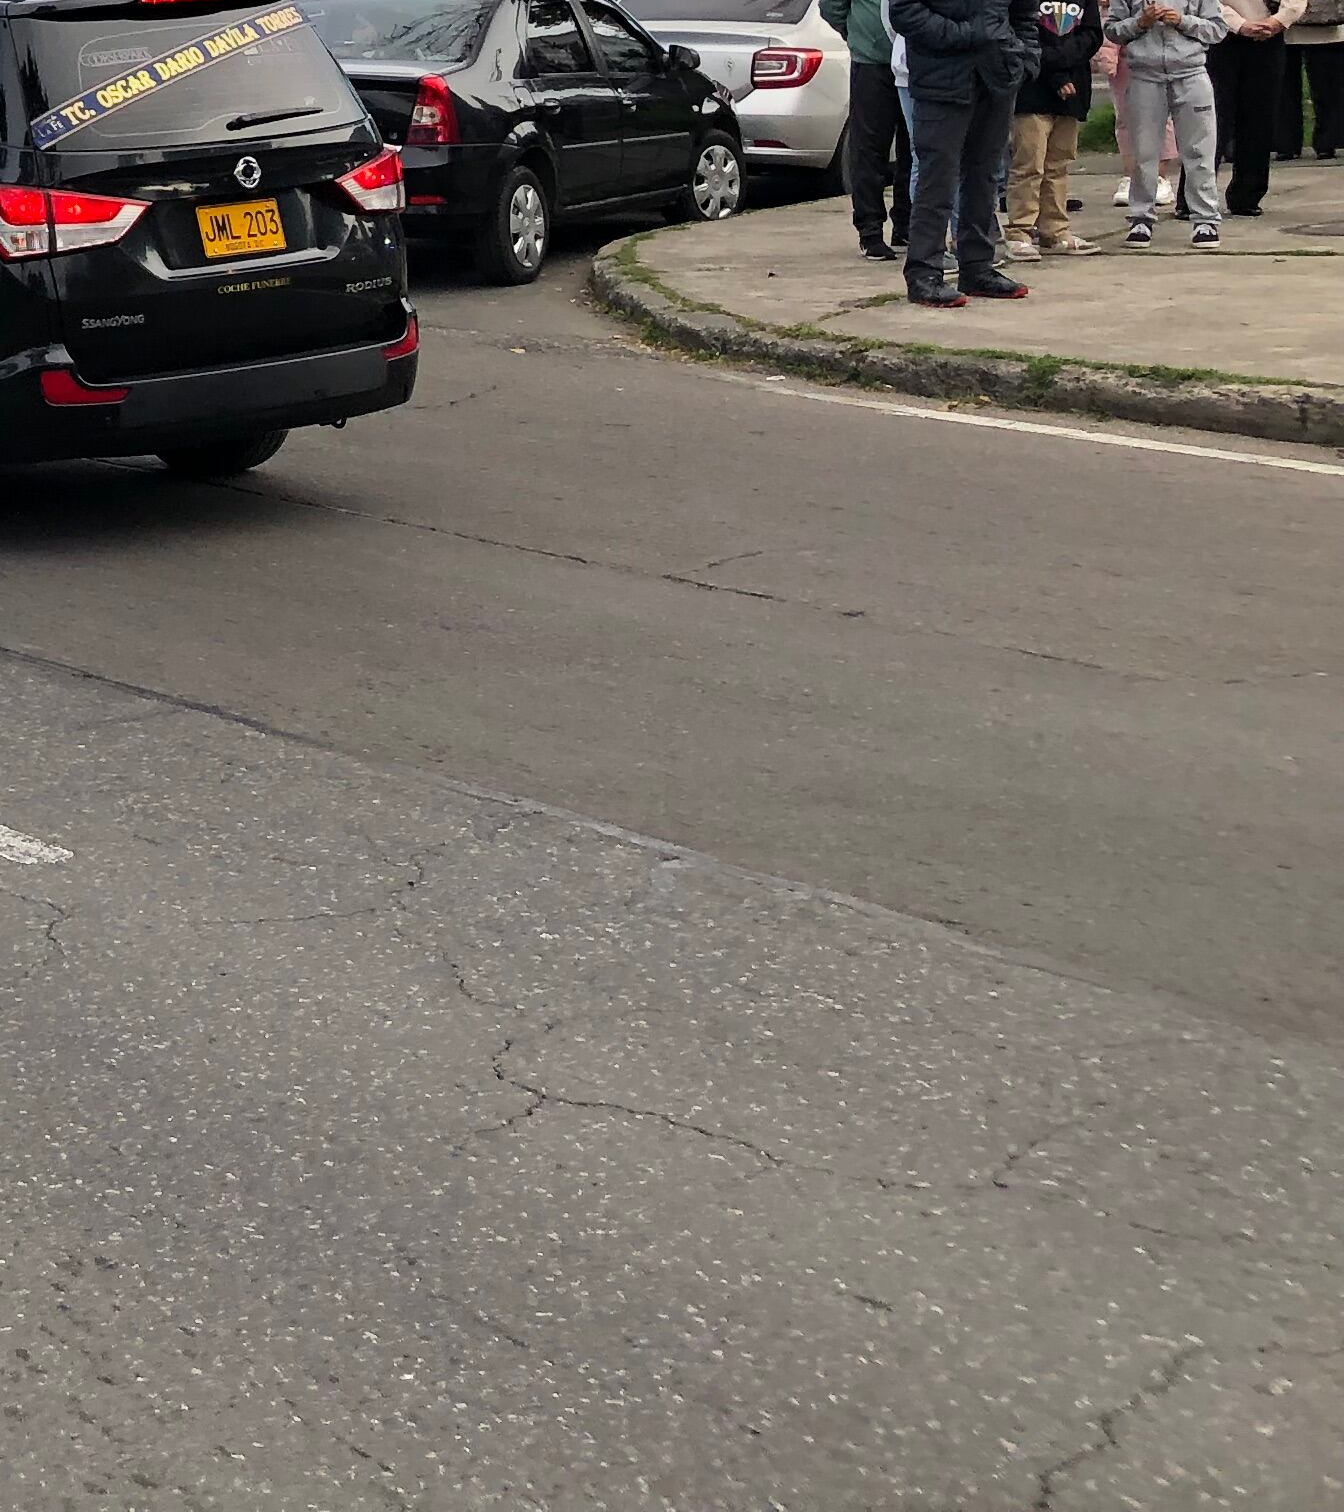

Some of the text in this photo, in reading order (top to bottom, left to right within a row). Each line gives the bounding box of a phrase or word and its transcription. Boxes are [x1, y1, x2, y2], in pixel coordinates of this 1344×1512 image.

[1037, 1, 1085, 18] CTIO
[95, 69, 157, 109] OSCAR
[153, 45, 205, 82] DARIO
[255, 6, 304, 35] TORRES
[205, 208, 280, 243] JML 203
[217, 282, 250, 294] COCHE
[346, 277, 393, 293] RODIUS
[81, 313, 145, 329] SSANGYONG
